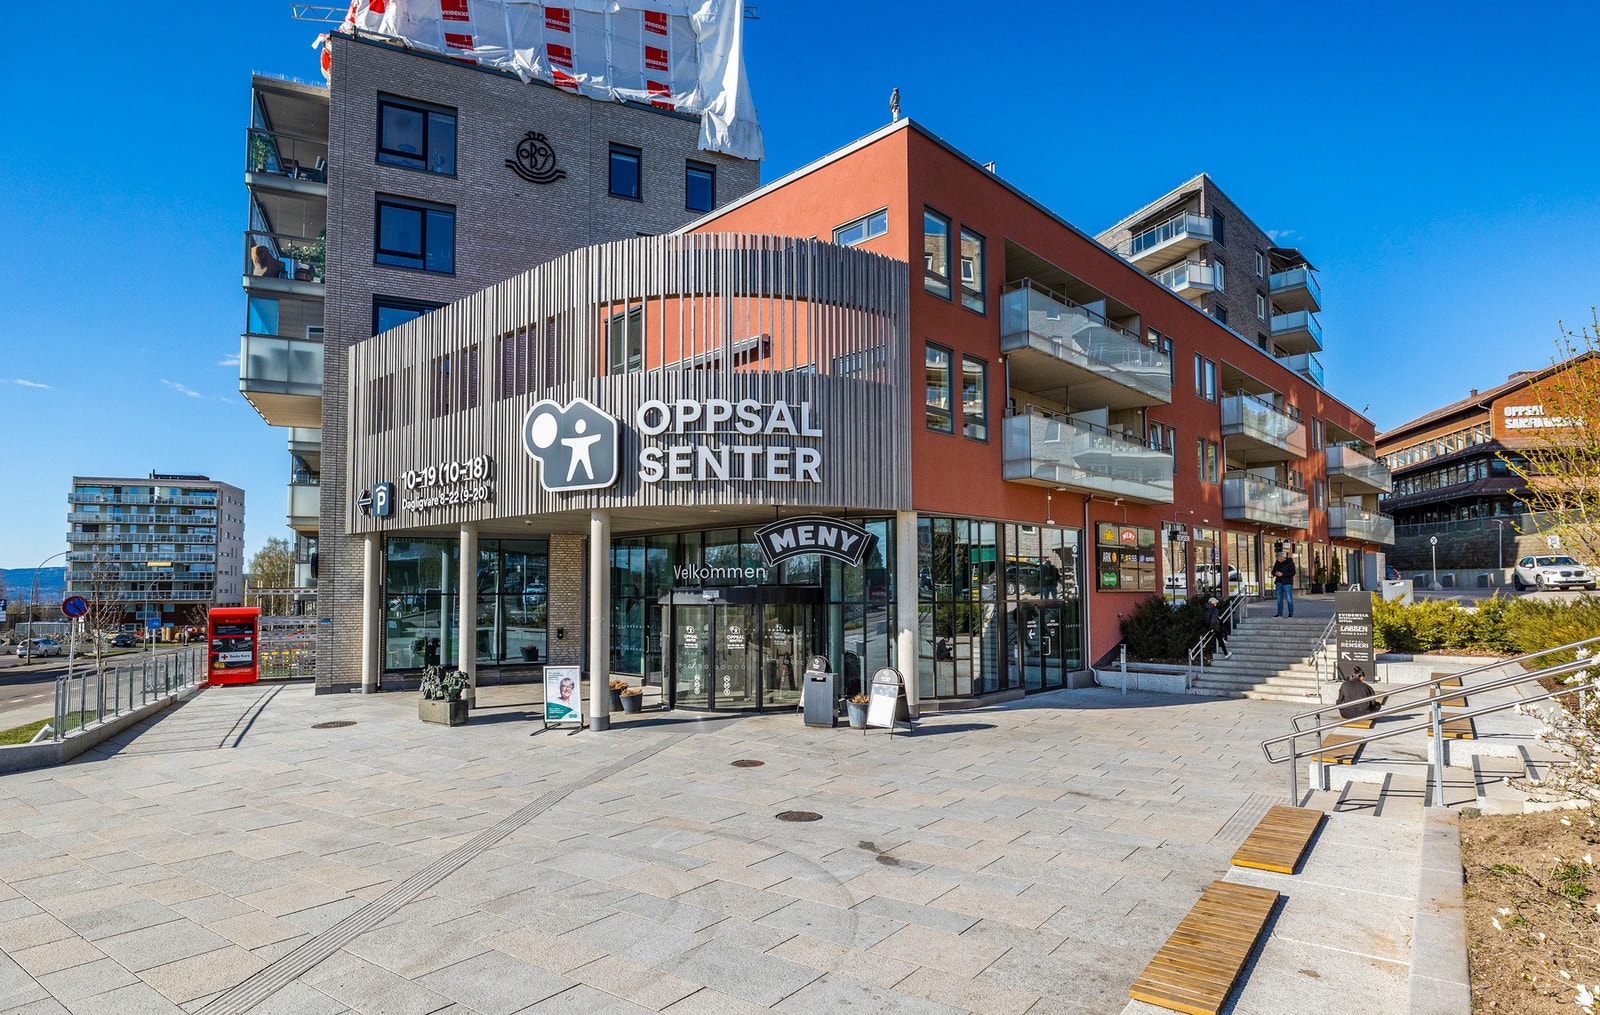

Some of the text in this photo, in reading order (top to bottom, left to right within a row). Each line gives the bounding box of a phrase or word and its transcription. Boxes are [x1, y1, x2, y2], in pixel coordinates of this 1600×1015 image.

[545, 18, 570, 28] VEIDEKKE
[645, 20, 668, 31] VEIDEKKE
[548, 54, 572, 64] VEIDEKKE
[645, 57, 668, 67] VEIDEKKE
[636, 398, 823, 437] OPPSAL
[1504, 405, 1545, 417] OPPSAL
[401, 454, 489, 490] 10-19 (10-18)
[638, 445, 822, 483] SENTER
[402, 485, 488, 512] Dagligvare 8-22 (9-20)
[769, 525, 859, 553] MENY
[673, 563, 767, 581] Velkommen
